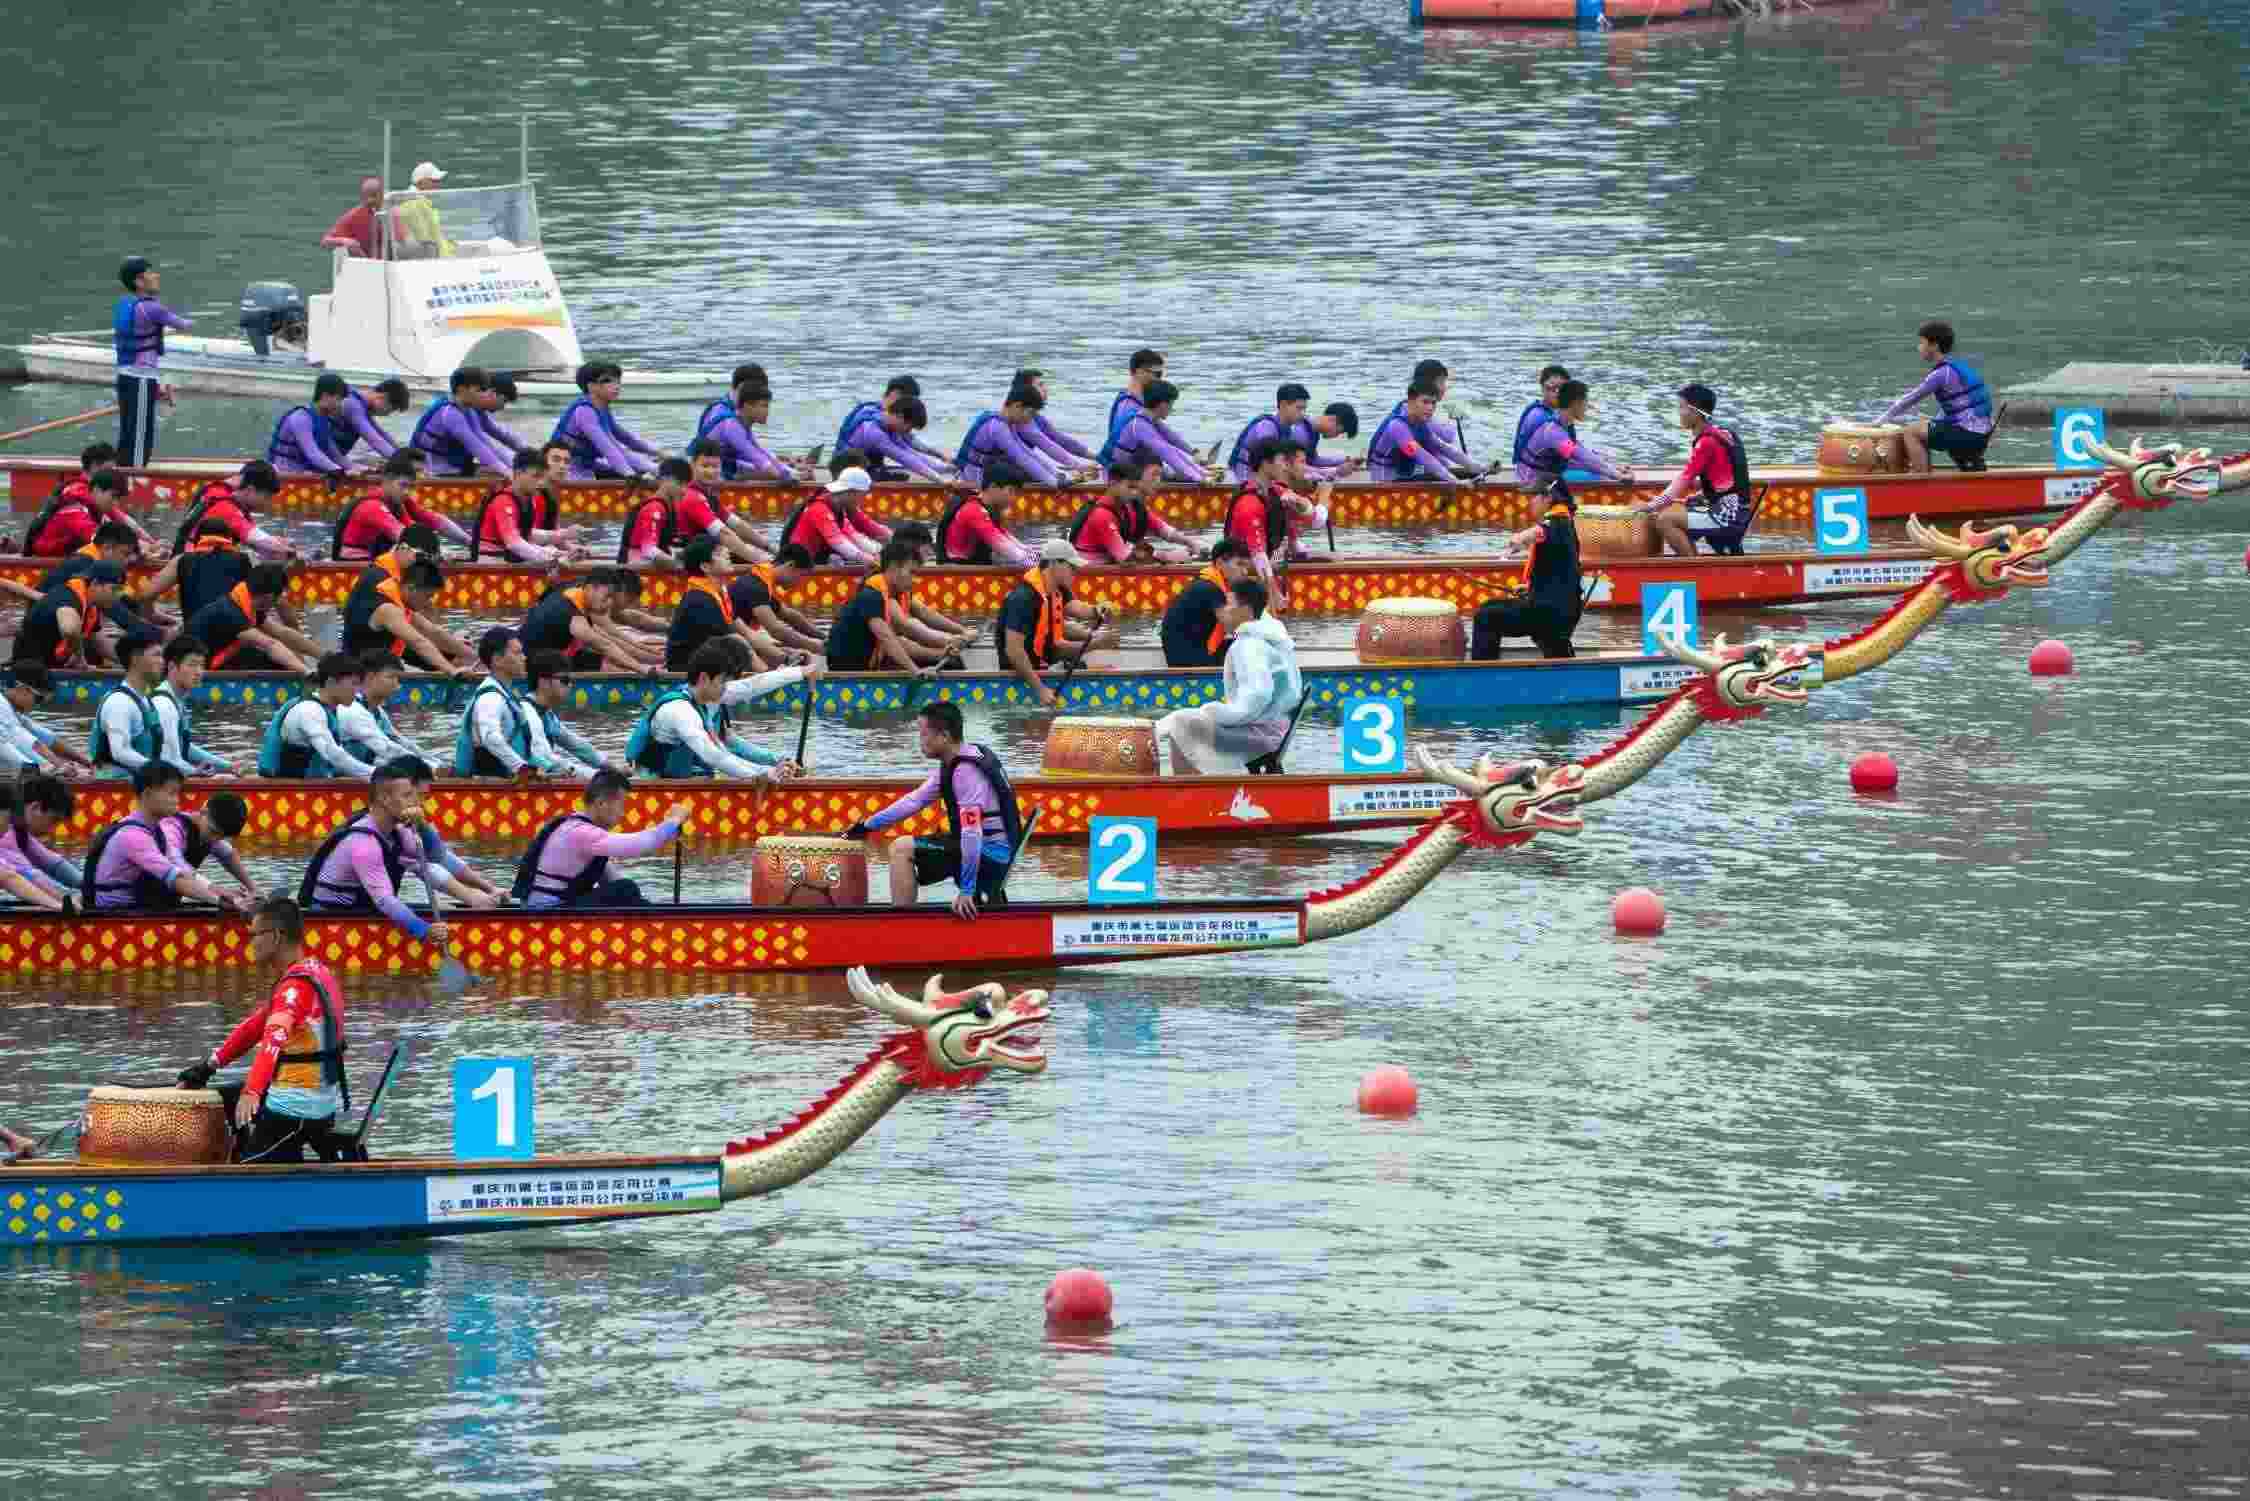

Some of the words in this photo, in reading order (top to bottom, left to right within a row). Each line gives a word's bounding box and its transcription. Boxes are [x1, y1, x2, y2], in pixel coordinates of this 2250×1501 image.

[2061, 413, 2097, 461] 6
[1823, 494, 1860, 547] 5
[1647, 591, 1693, 643] 4
[1351, 702, 1395, 765] 3
[1097, 825, 1146, 892] 2
[471, 1067, 515, 1146] 1
